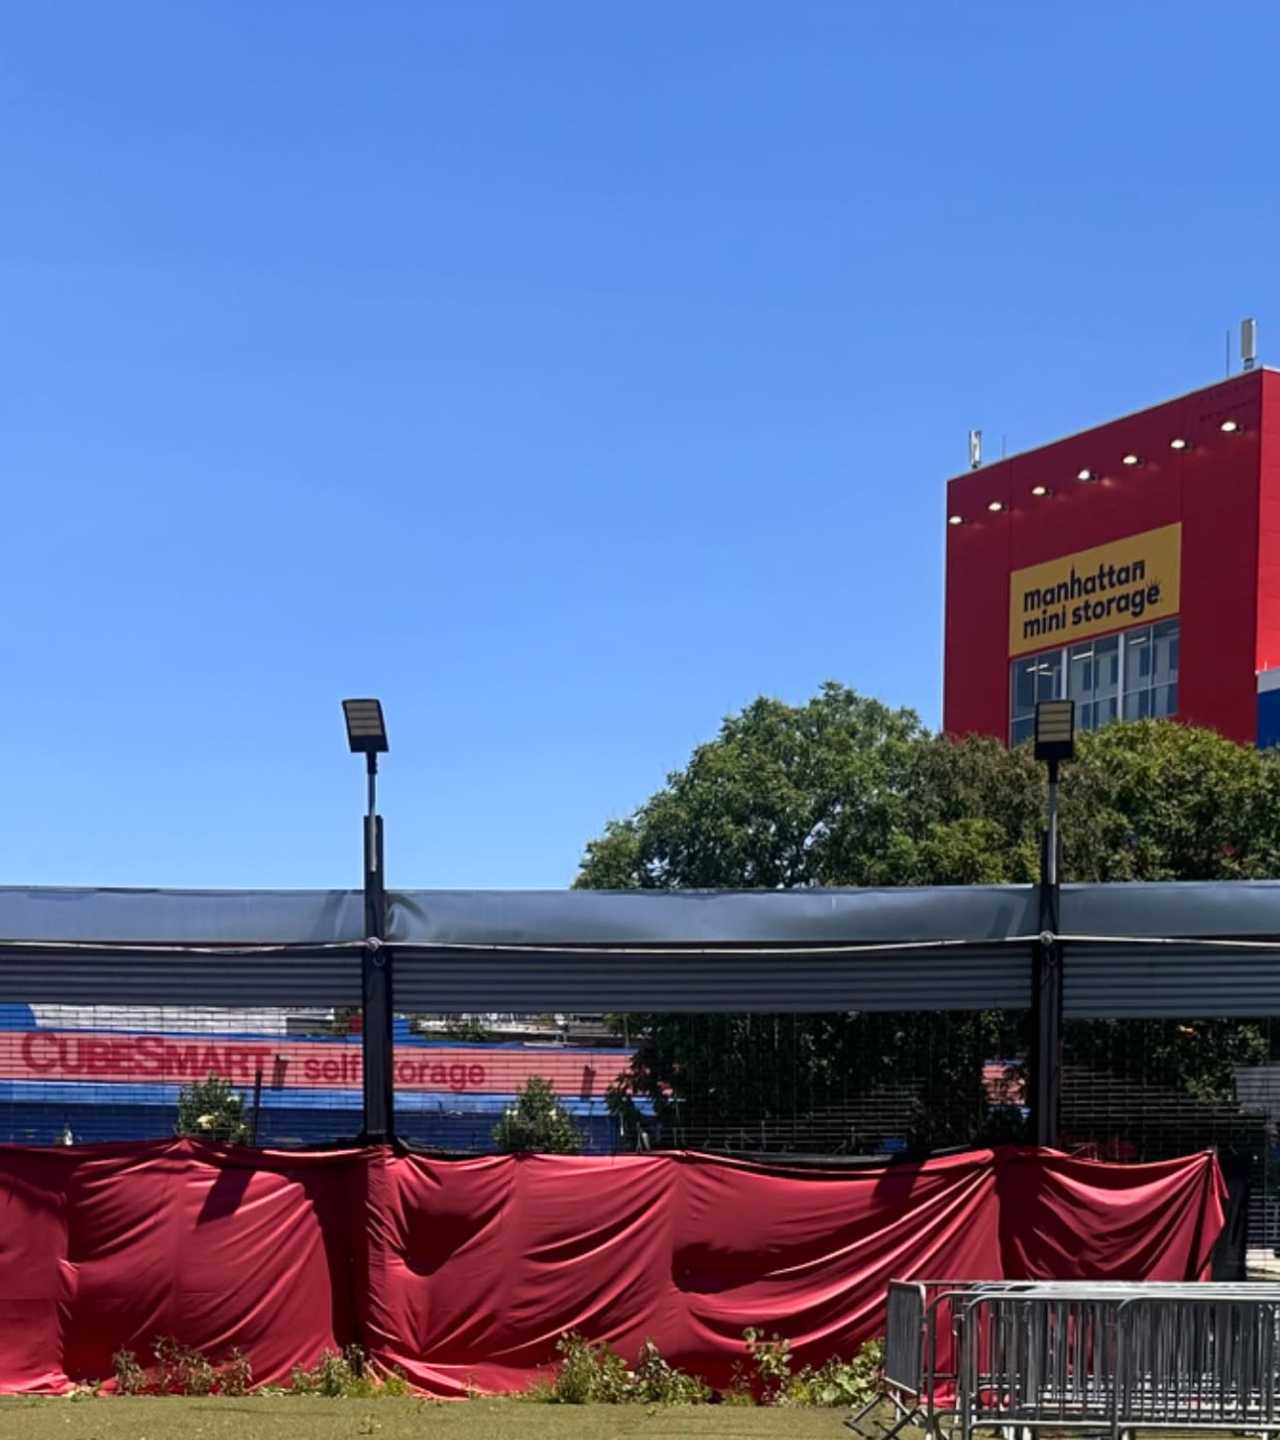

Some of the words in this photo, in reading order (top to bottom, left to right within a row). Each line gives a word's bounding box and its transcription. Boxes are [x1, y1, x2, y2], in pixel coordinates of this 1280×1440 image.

[1022, 604, 1067, 640] mini
[1071, 585, 1160, 627] storage
[1023, 560, 1146, 613] manhattan
[304, 1053, 361, 1081] self
[392, 1060, 485, 1091] orage
